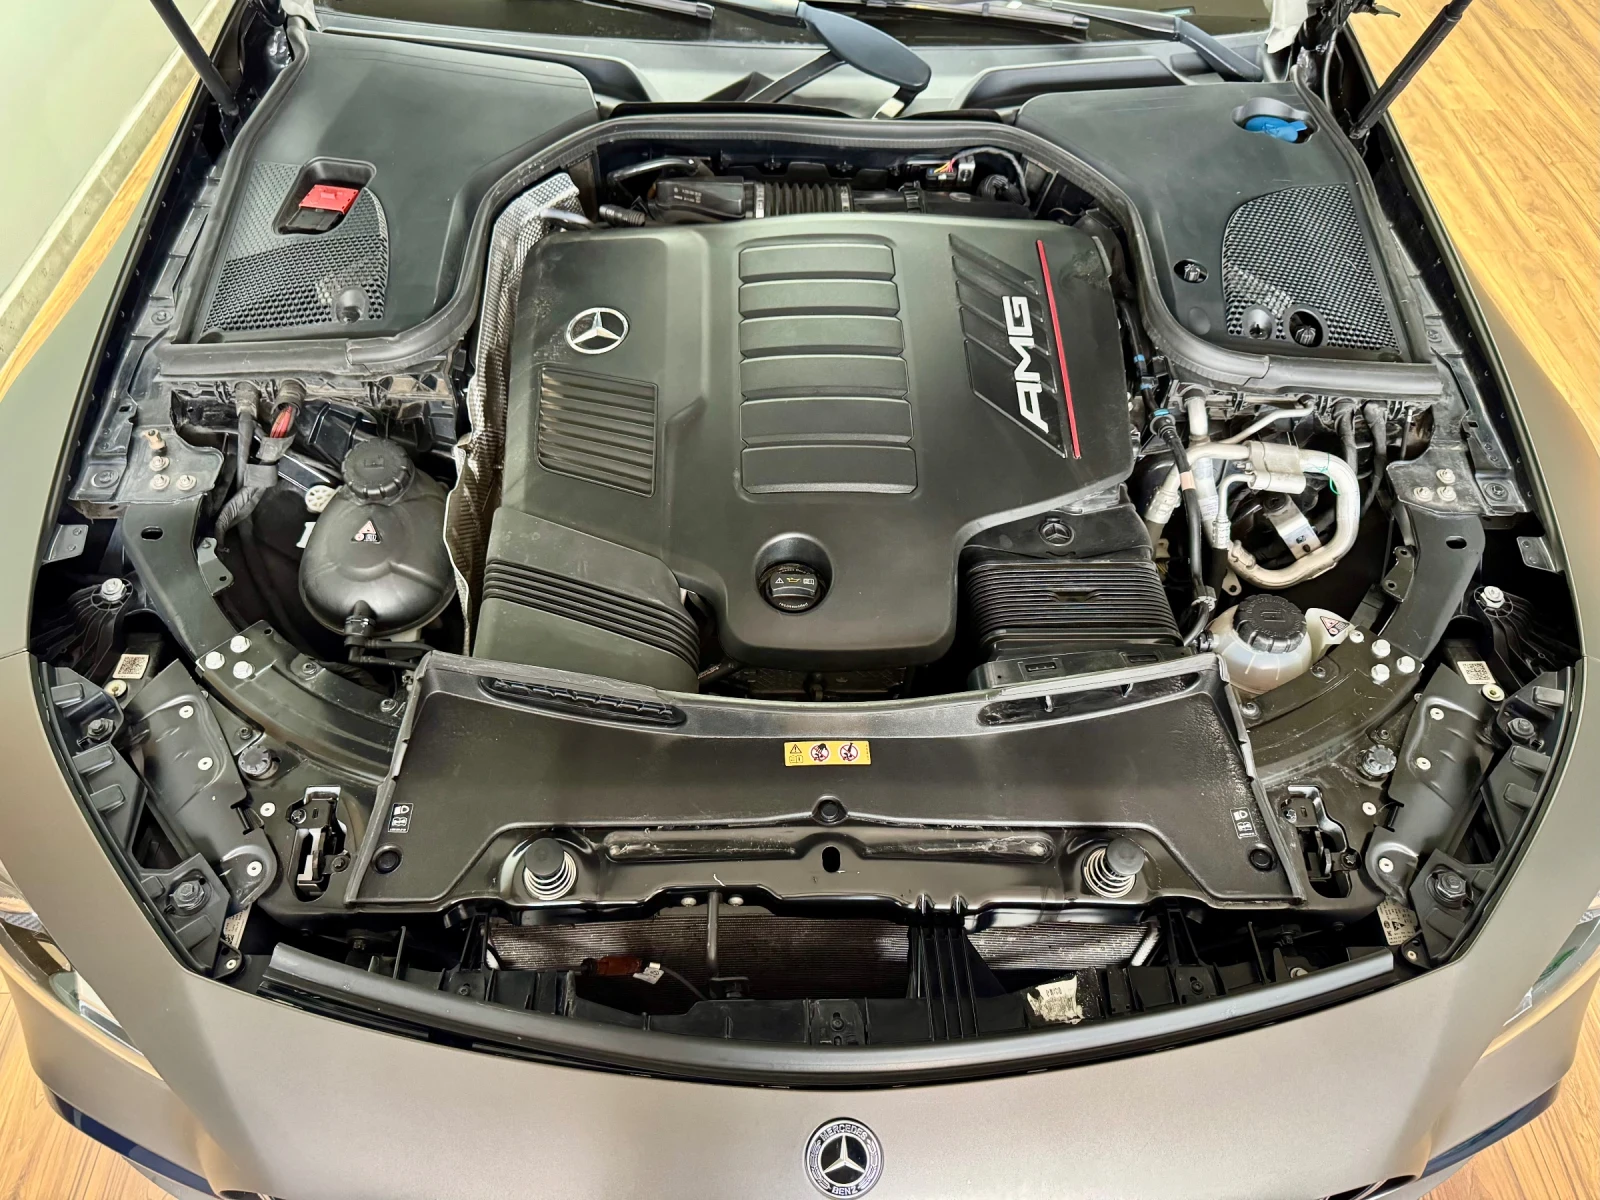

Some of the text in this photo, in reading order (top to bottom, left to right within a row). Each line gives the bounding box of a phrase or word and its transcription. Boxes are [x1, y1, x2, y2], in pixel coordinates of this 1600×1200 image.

[1002, 296, 1049, 434] AMG
[820, 1124, 868, 1141] MERCEDES
[831, 1186, 858, 1195] BENZ
